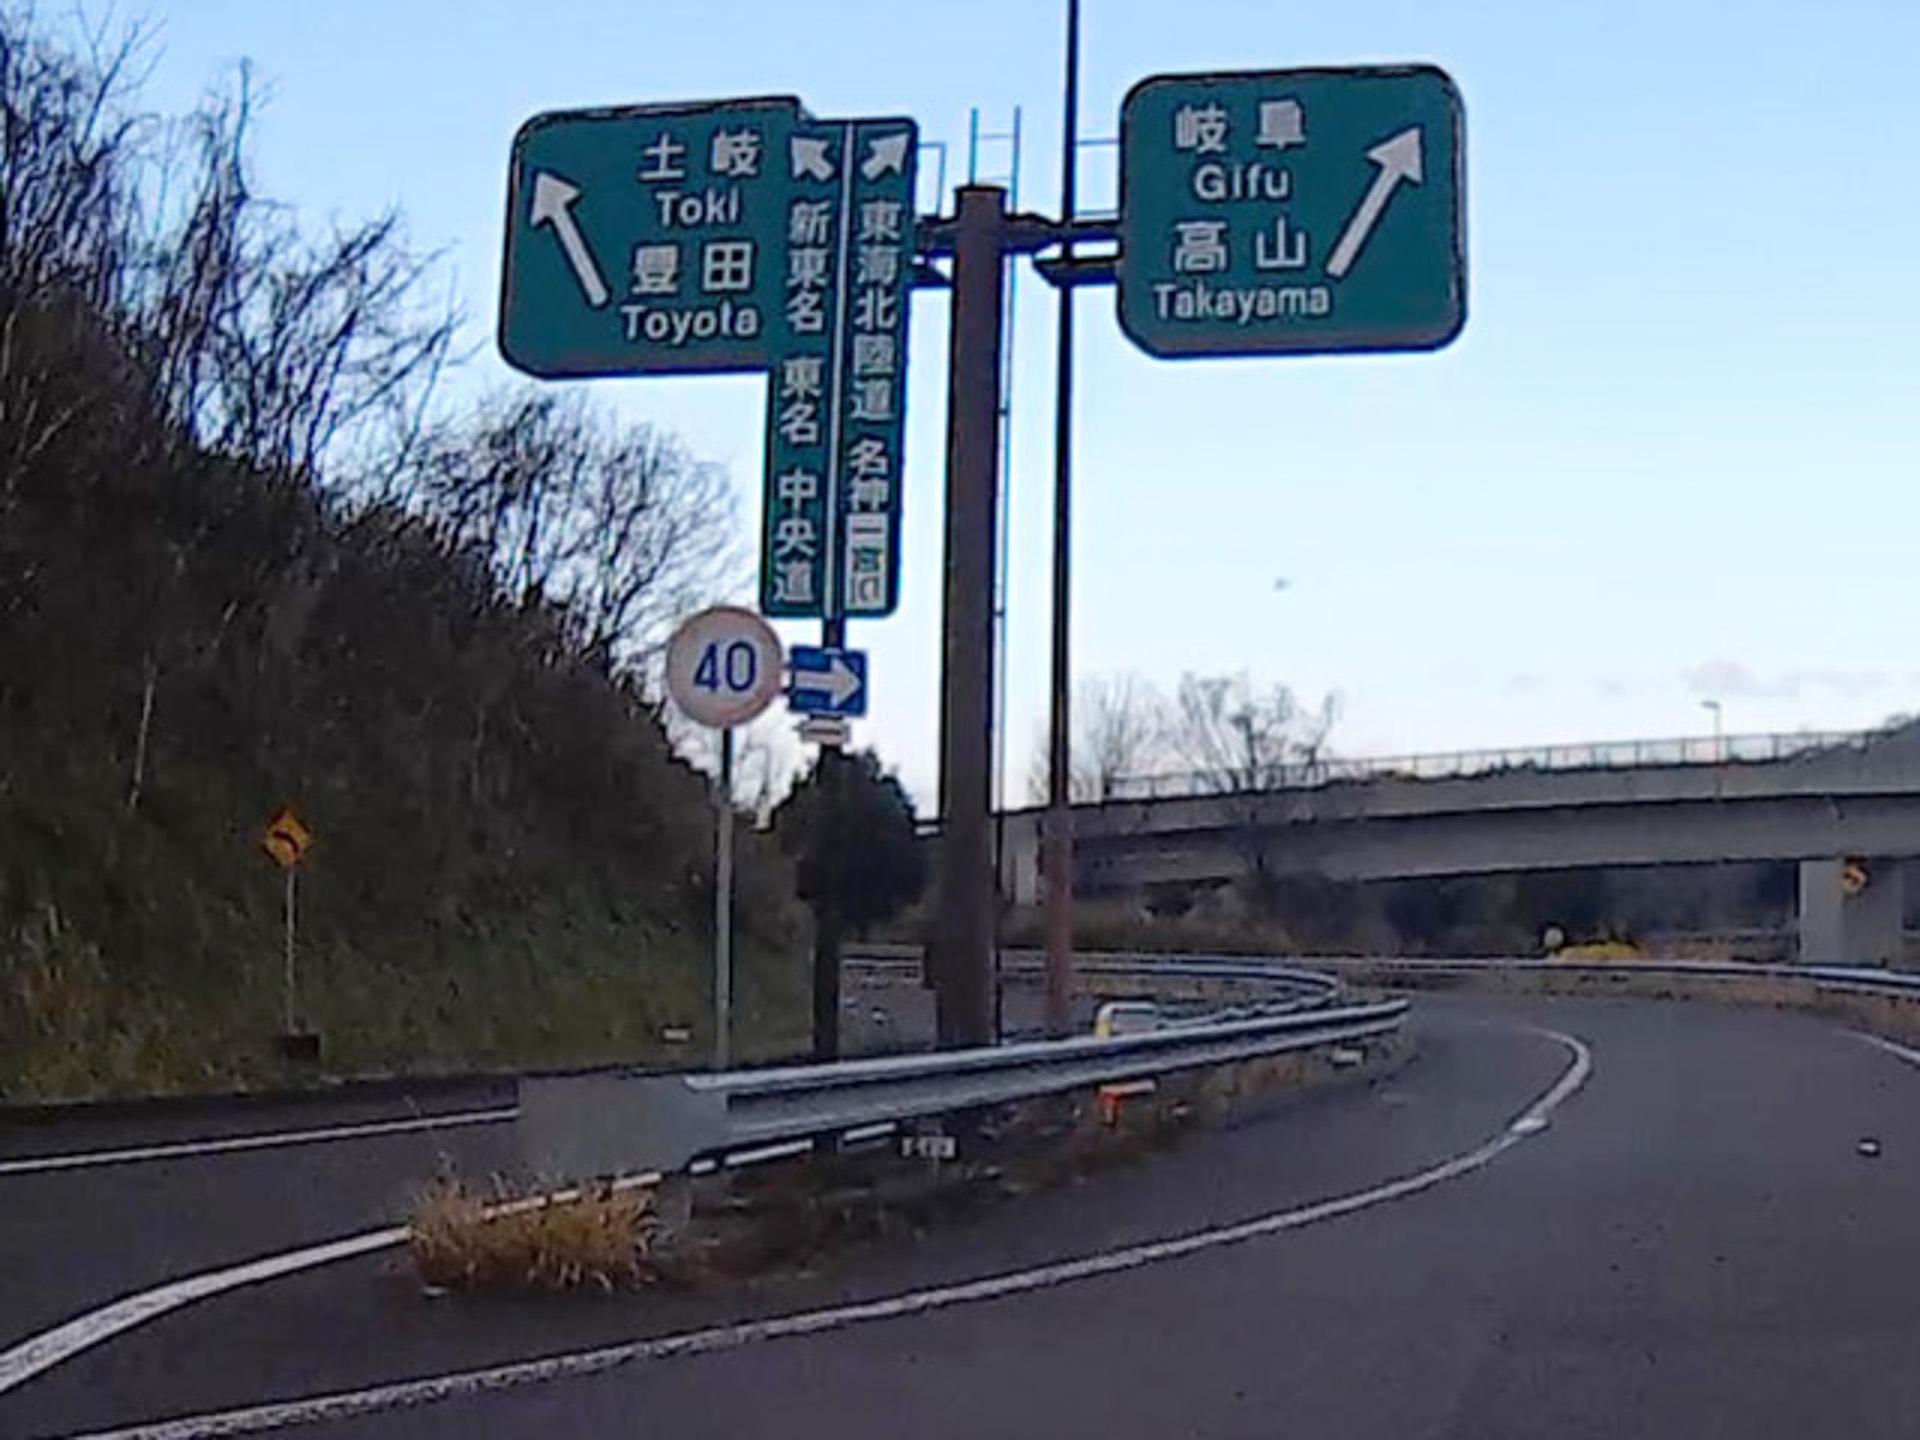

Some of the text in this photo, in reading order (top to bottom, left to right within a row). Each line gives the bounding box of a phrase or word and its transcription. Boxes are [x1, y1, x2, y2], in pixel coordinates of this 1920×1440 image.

[640, 129, 760, 180] 土岐
[656, 187, 739, 226] Toki
[1194, 164, 1289, 200] Gifu
[632, 241, 753, 294] 豊田
[1174, 216, 1306, 272] 高山
[620, 302, 759, 345] Toyota
[1154, 280, 1331, 324] Takayama
[773, 200, 831, 603] 新東名 東名 中央道
[694, 641, 756, 691] 40
